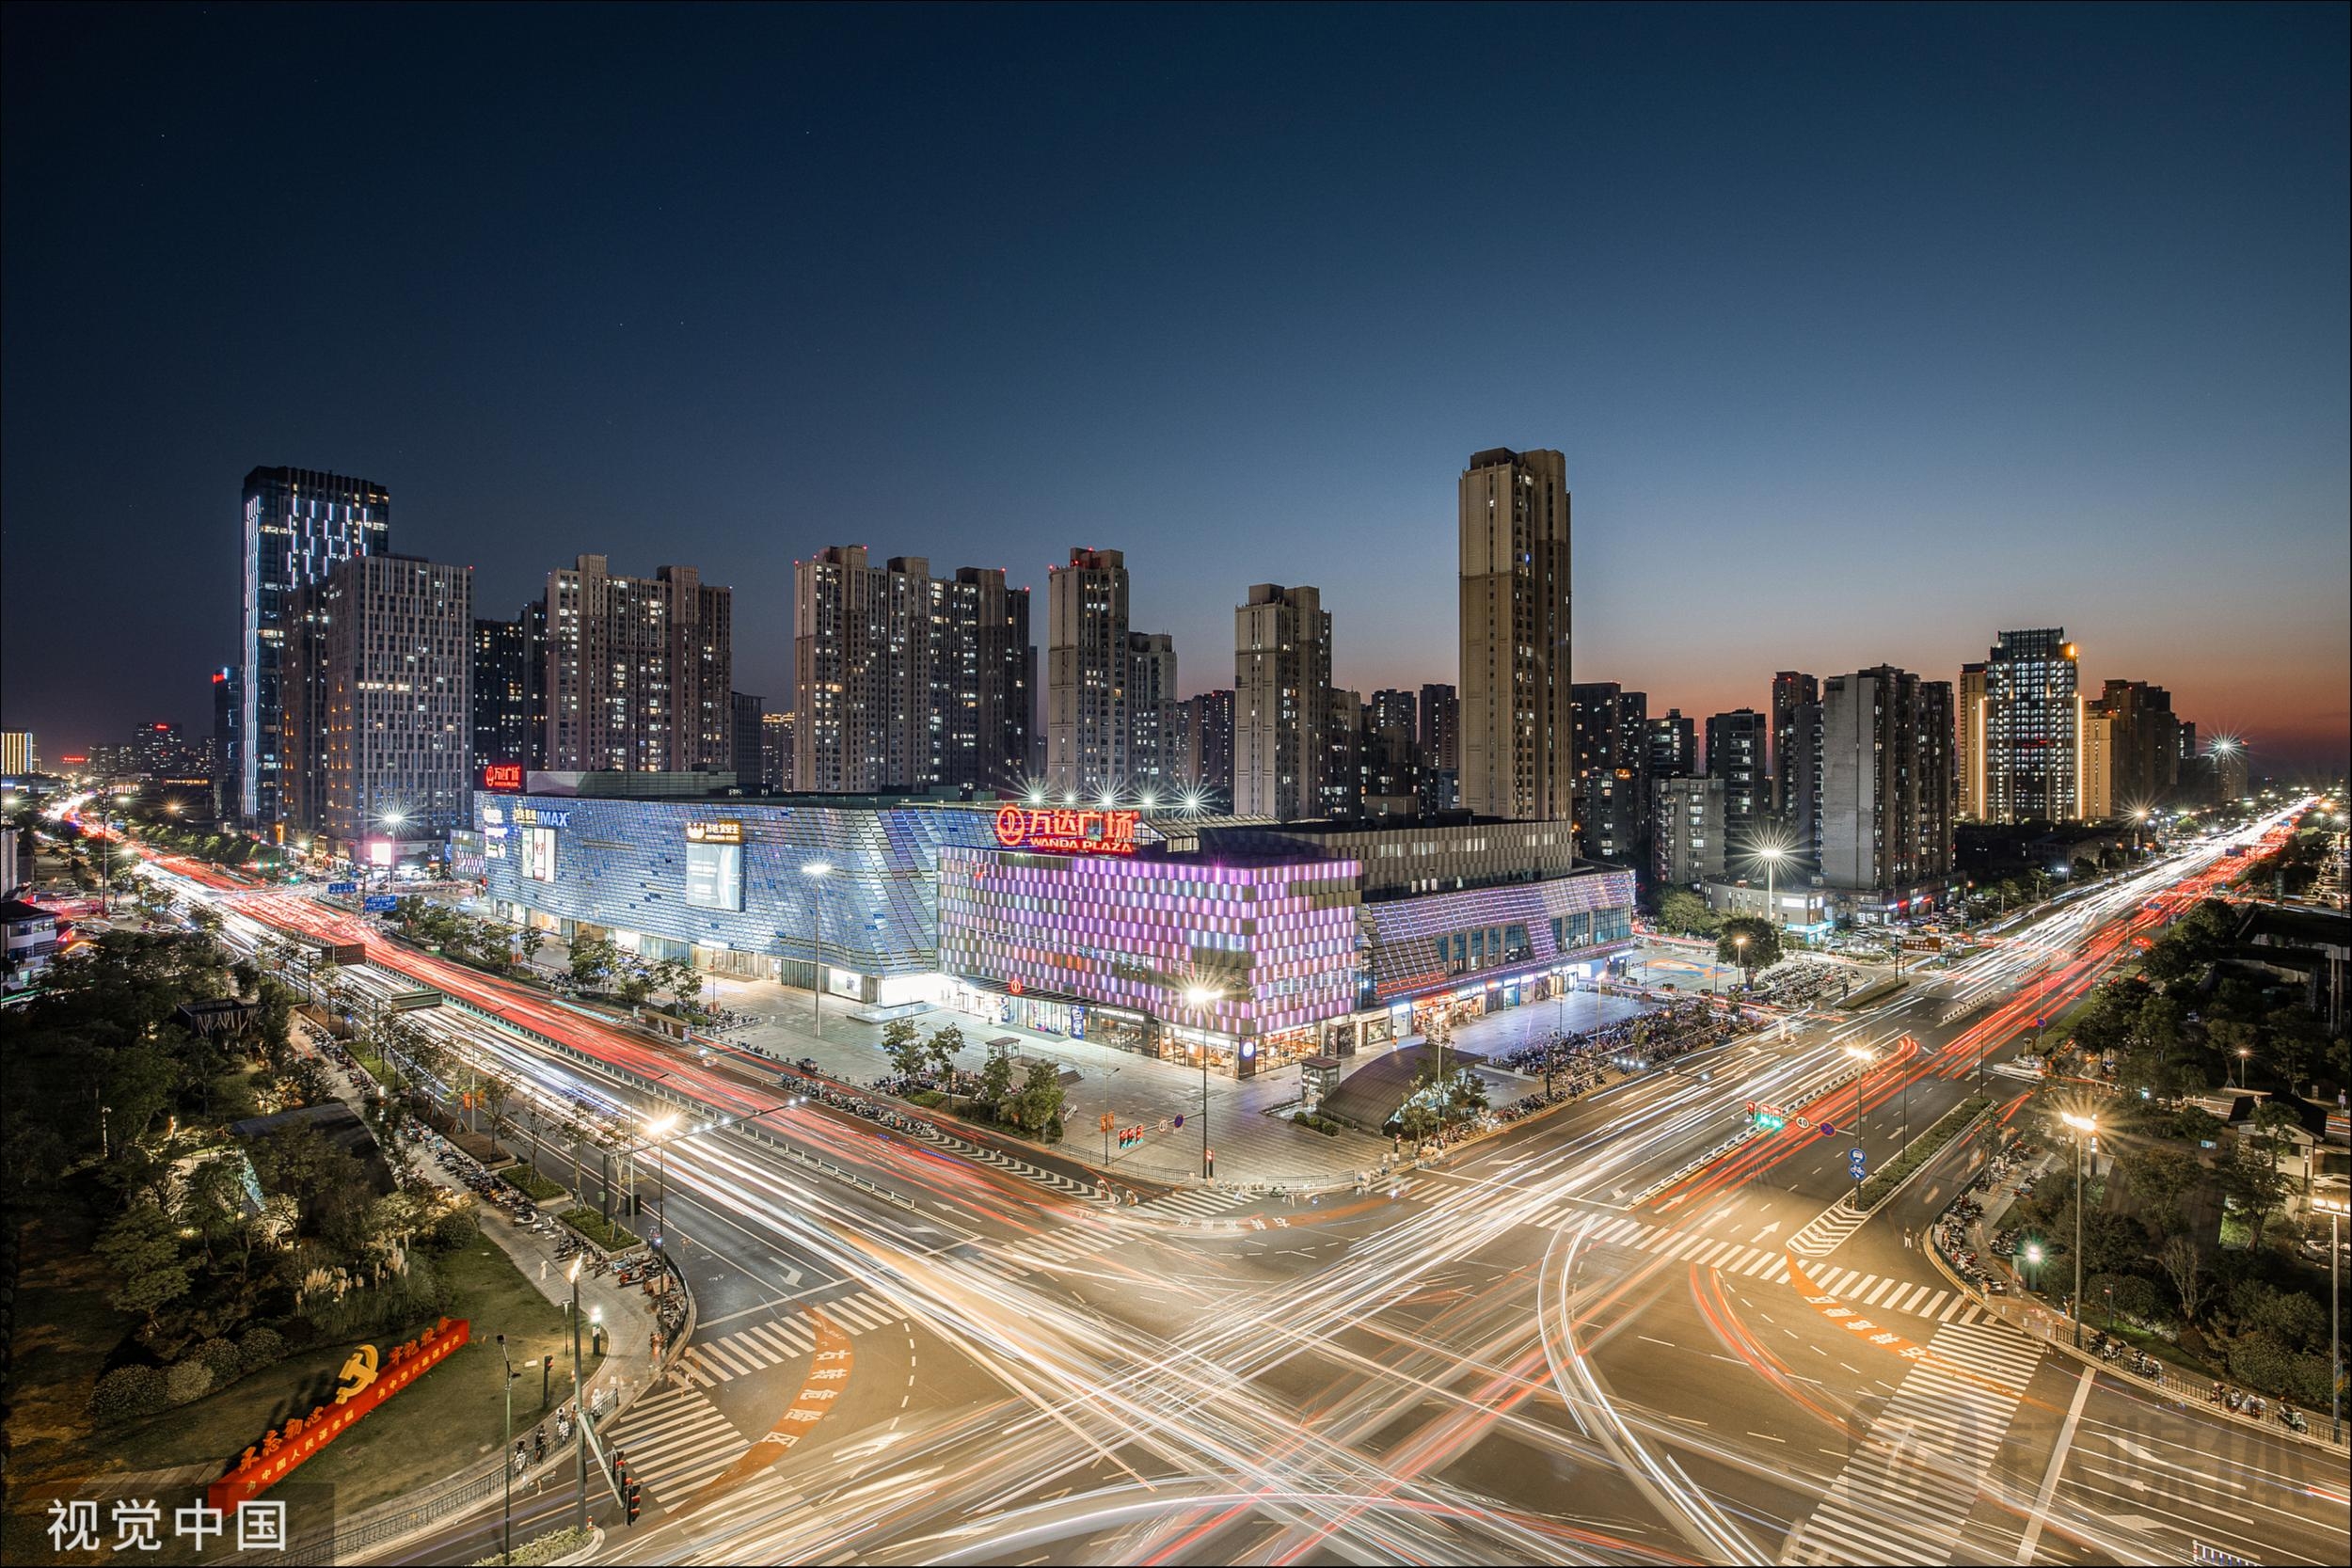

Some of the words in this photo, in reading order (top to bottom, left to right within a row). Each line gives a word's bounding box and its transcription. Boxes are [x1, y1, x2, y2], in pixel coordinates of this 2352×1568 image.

[537, 811, 567, 826] IMAX
[1029, 810, 1134, 839] 万达广场
[1029, 837, 1078, 848] WANDA
[1083, 841, 1133, 853] PLAZA
[1804, 1295, 1927, 1359] 右转危险区
[760, 1349, 850, 1448] 右转危险区
